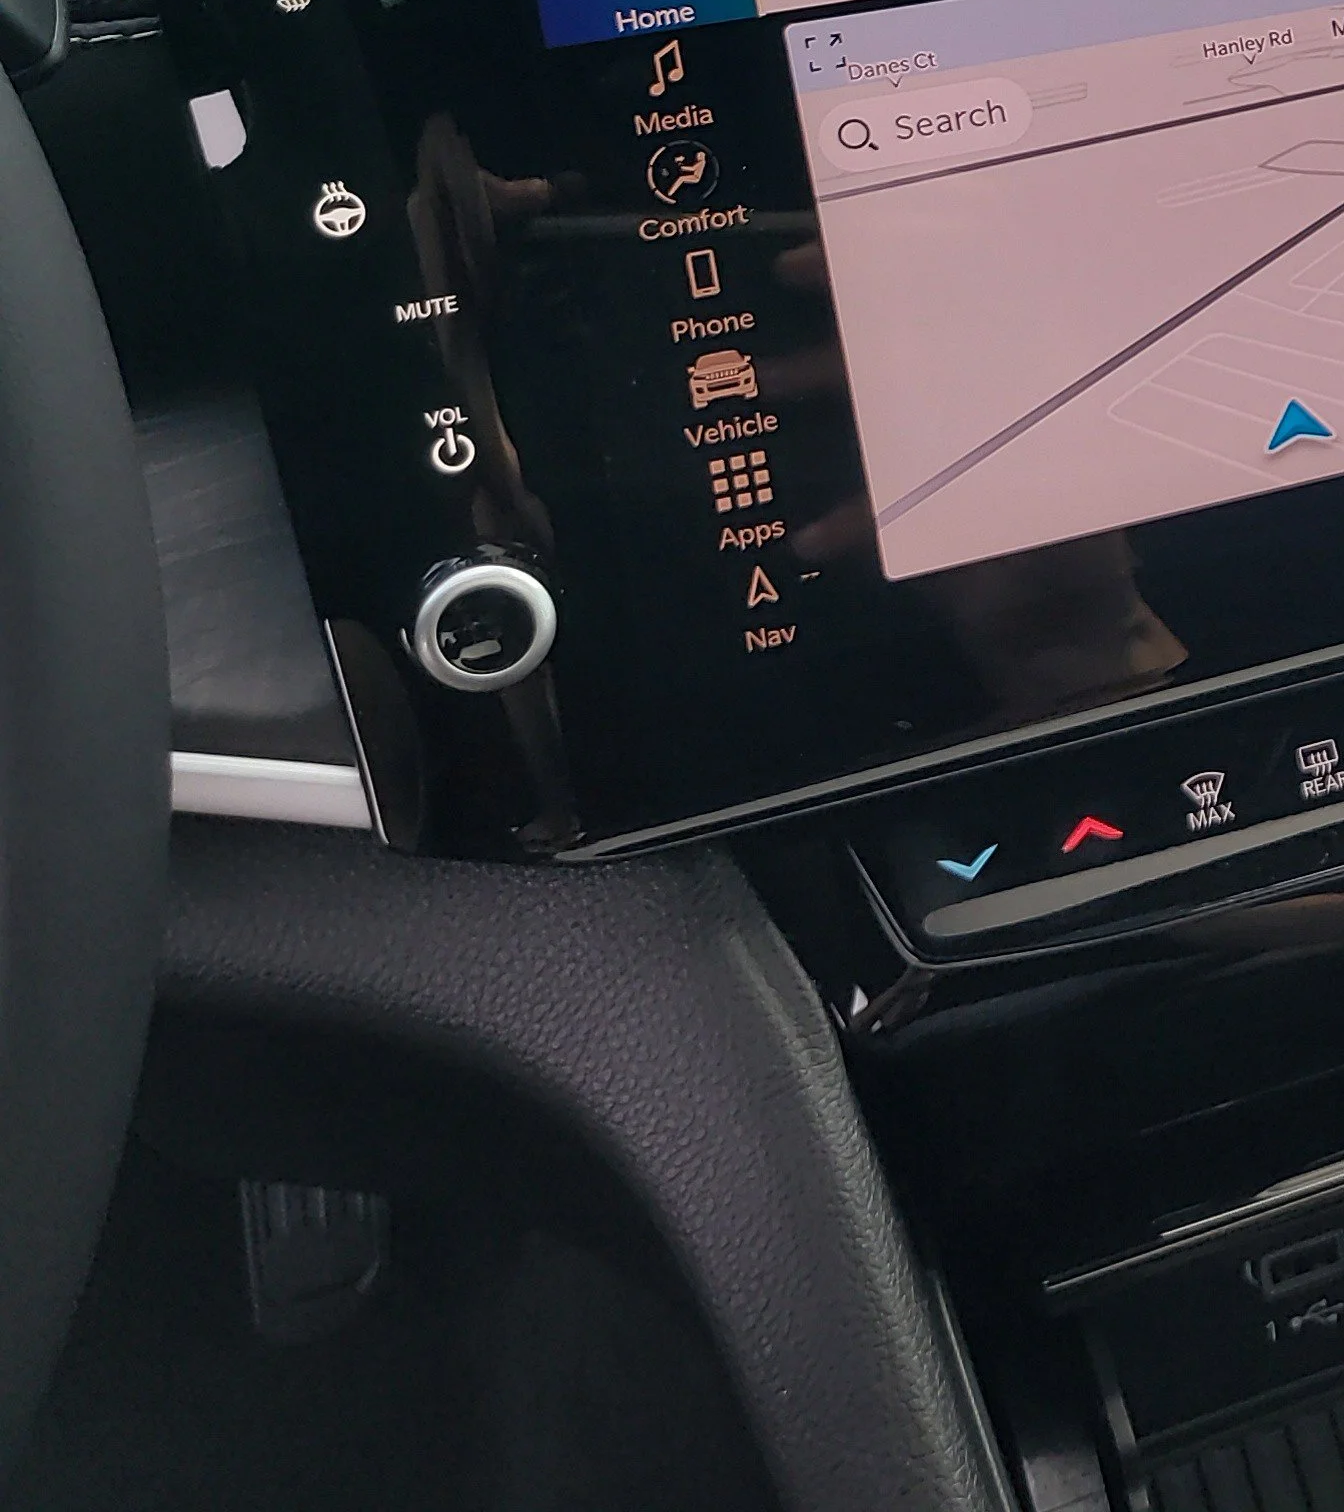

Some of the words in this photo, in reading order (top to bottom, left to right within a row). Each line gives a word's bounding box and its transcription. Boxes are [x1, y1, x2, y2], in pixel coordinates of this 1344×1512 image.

[614, 5, 696, 33] Home
[1202, 34, 1265, 61] Hanley
[1268, 28, 1294, 50] Rd
[847, 55, 908, 81] Danes
[914, 51, 938, 71] Ct
[633, 105, 714, 136] Media
[894, 99, 1008, 141] Search
[638, 204, 750, 241] Comfort
[395, 294, 460, 324] MUTE
[671, 312, 756, 343] Phone
[424, 406, 469, 429] VOL
[684, 412, 779, 448] Vehicle
[719, 520, 786, 551] Apps
[744, 625, 797, 652] Nav
[1185, 801, 1237, 832] MAX
